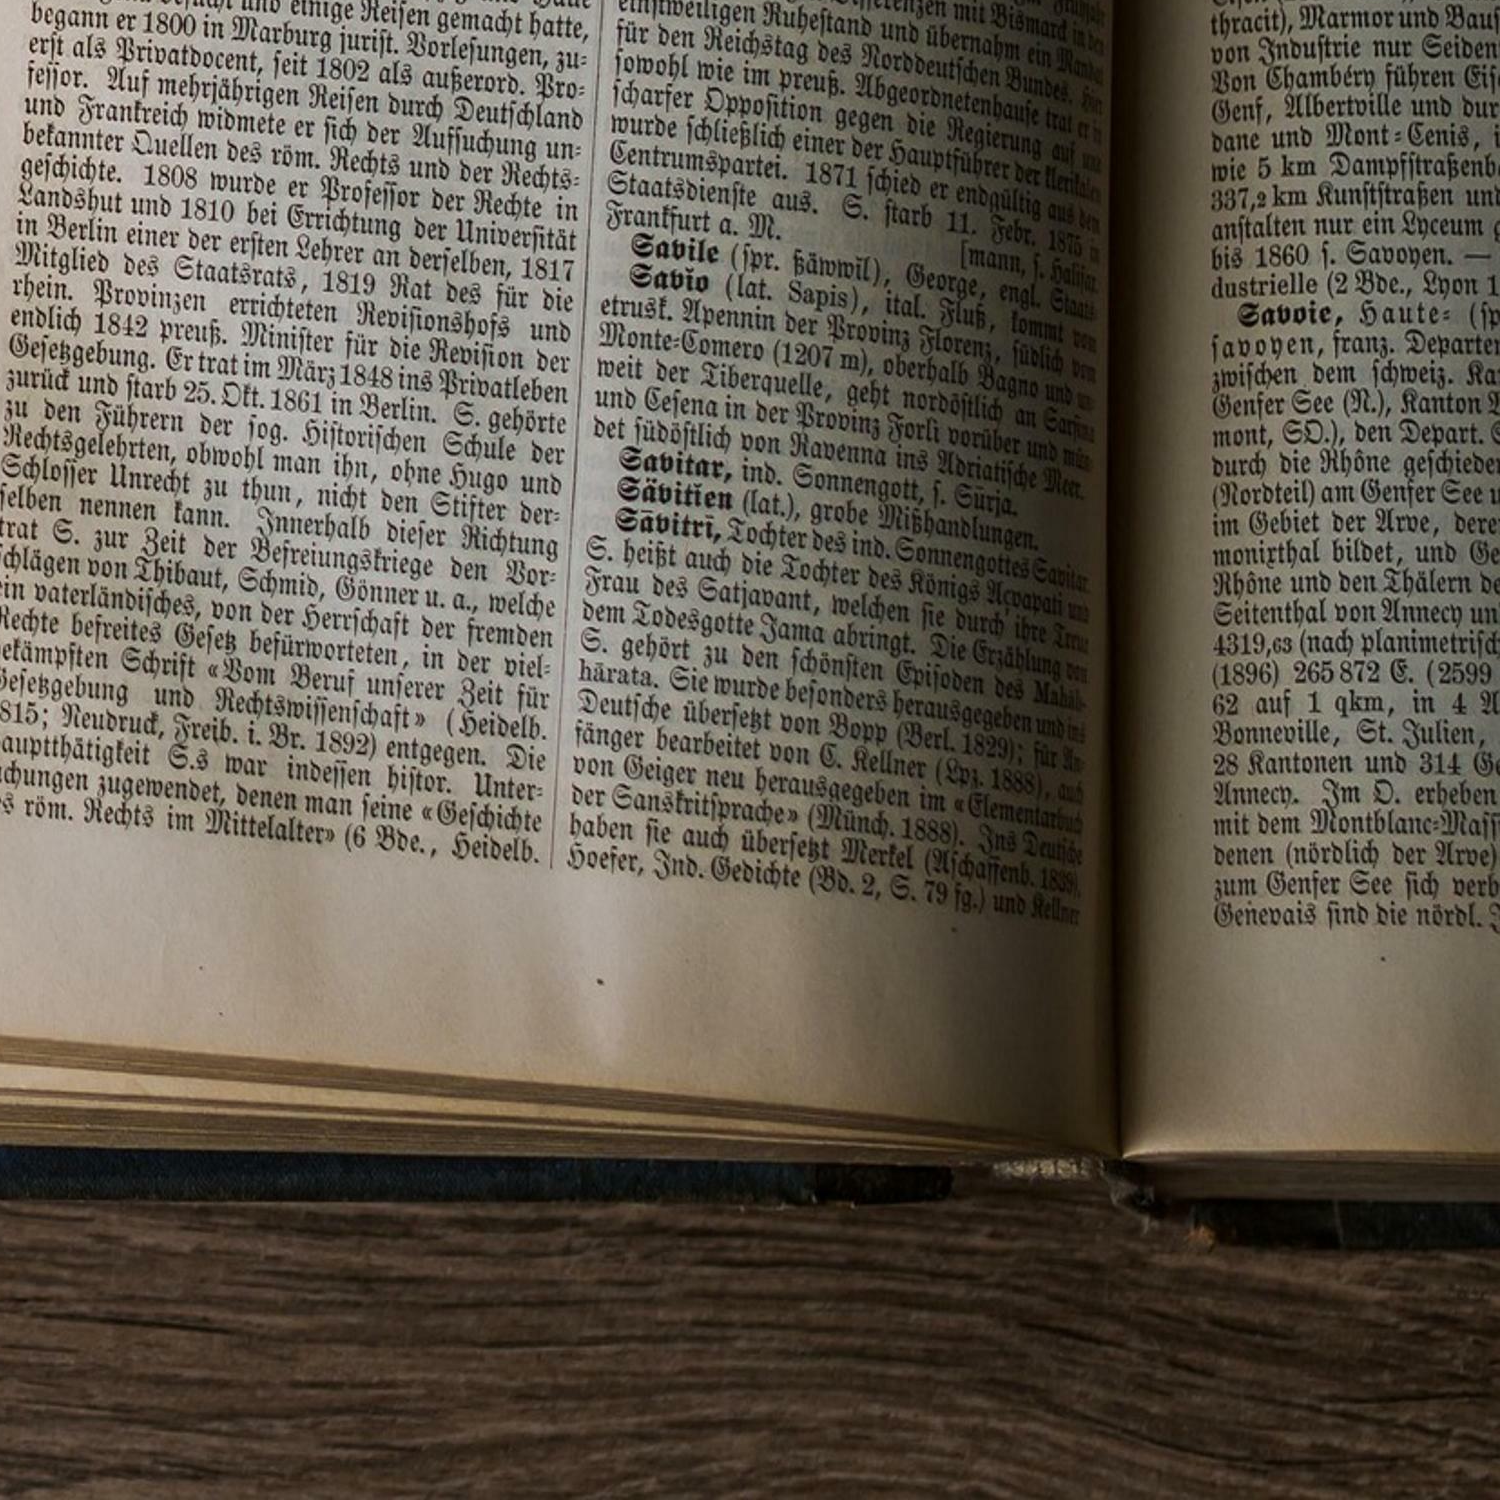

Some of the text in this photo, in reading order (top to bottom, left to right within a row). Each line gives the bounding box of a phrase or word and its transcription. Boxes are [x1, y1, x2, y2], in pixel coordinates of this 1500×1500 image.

[31, 2, 332, 53] begann 1800 Marburg
[616, 19, 808, 66] für Reichstag
[631, 232, 719, 263] Savile
[1211, 244, 1309, 272] bis 1860
[788, 280, 869, 316] Sapis),
[1211, 272, 1318, 299] dustrielle
[1238, 301, 1344, 328] Savoie,
[701, 361, 890, 409] Tiberquelle, geht
[96, 400, 183, 434] Führern
[1212, 388, 1482, 419] Genfer See Kanton
[110, 462, 190, 497] Unrecht
[619, 446, 732, 483] Savitar,
[1212, 451, 1267, 479] durch
[810, 501, 868, 526] grobe
[727, 517, 808, 550] Tochter
[584, 565, 640, 597] Frau
[62, 703, 164, 740] Neudruck,
[1213, 720, 1340, 746] Bonneville,
[1214, 750, 1460, 776] 28 Kantonen 314
[24, 797, 73, 821] röm.
[84, 798, 154, 830] Rechts
[452, 831, 538, 864] Heidelb.
